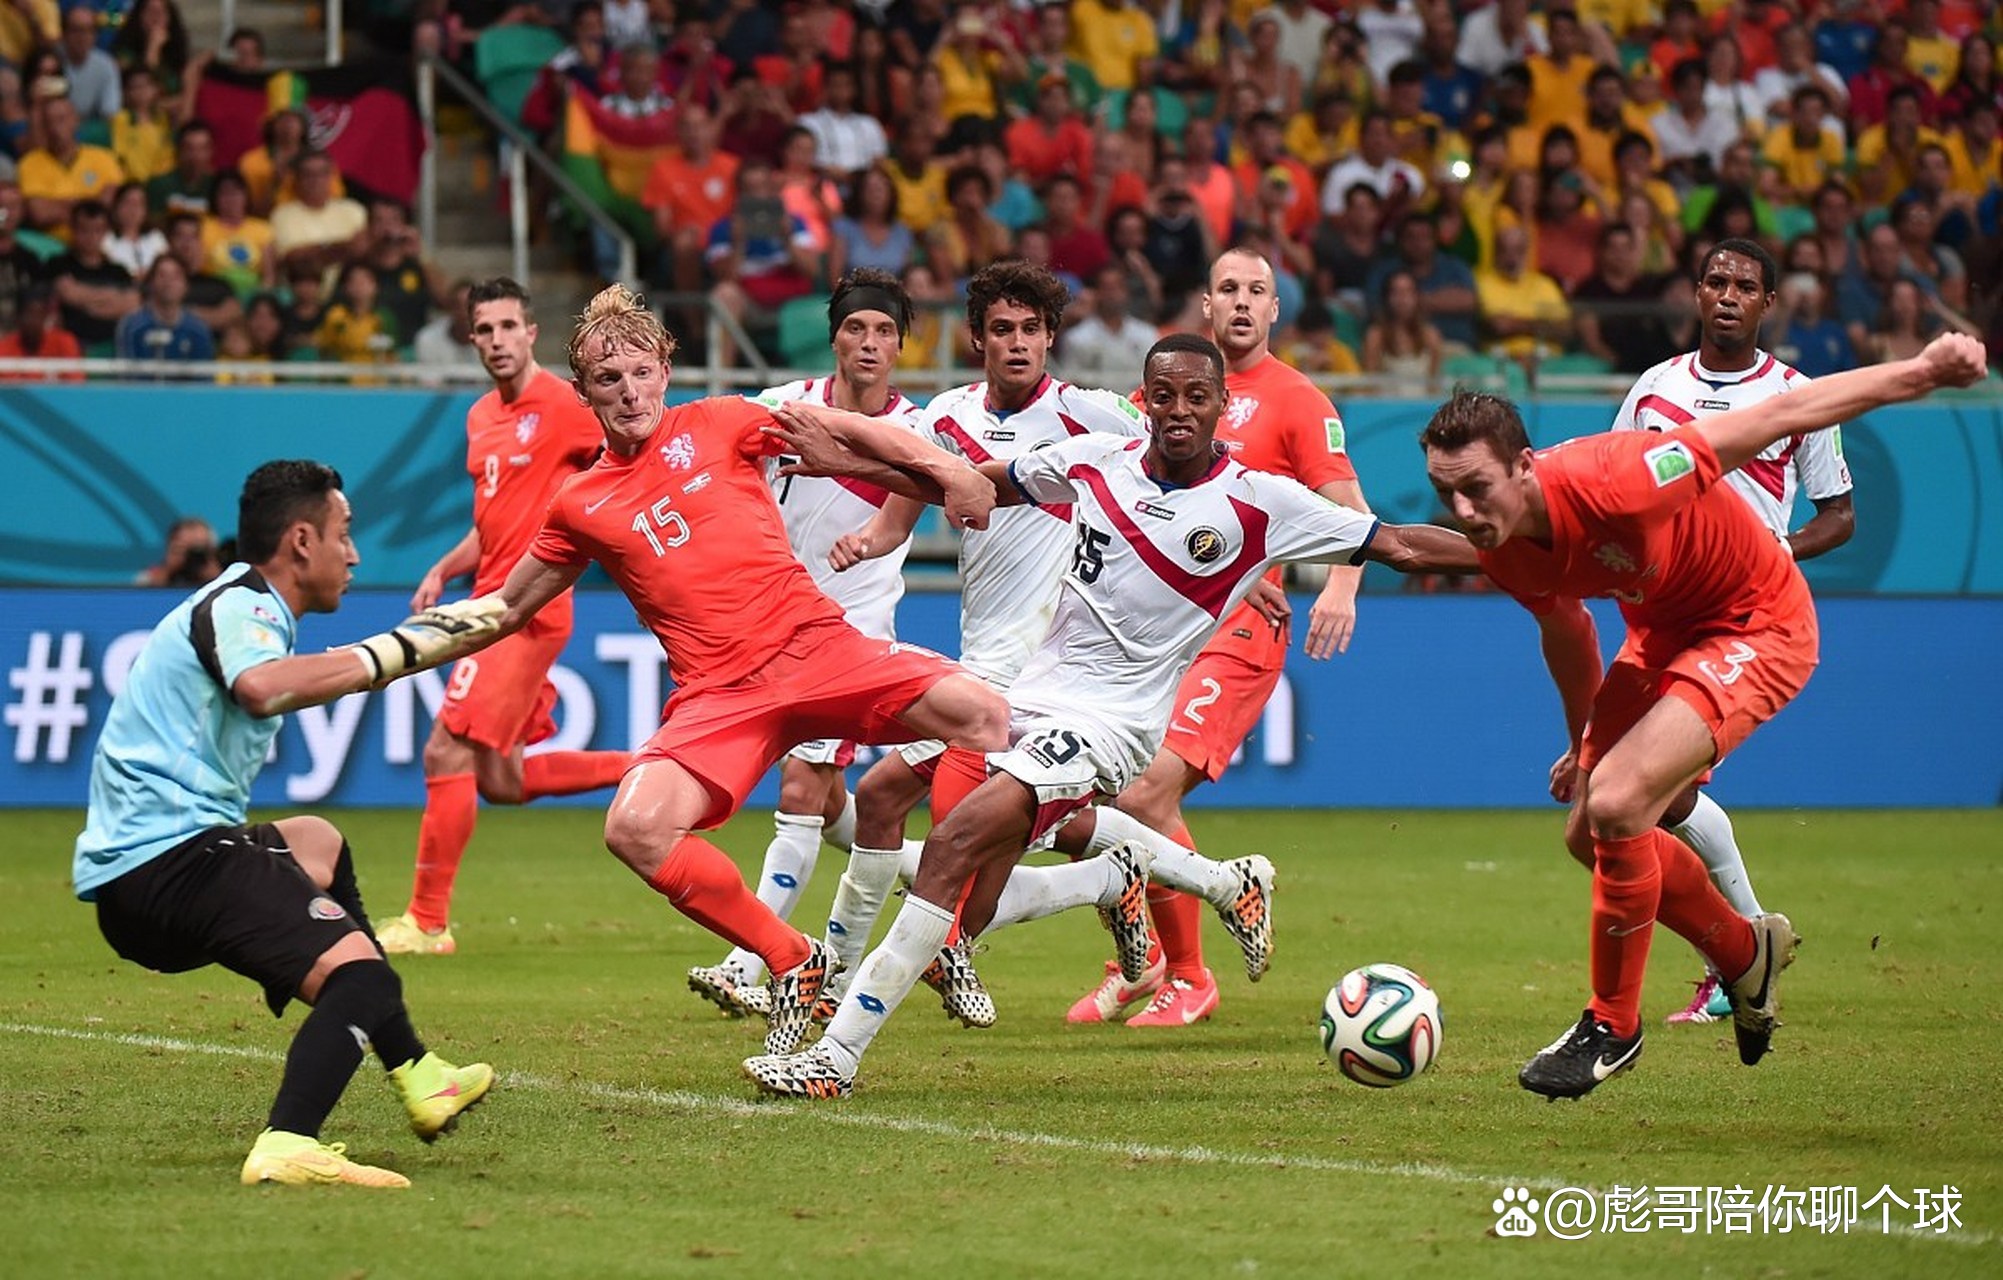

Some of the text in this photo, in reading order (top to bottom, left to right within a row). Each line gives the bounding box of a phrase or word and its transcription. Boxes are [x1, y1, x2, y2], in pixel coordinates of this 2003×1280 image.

[483, 454, 499, 498] 9
[632, 495, 691, 557] 15
[447, 657, 478, 699] 9
[1711, 641, 1757, 685] 3
[1184, 677, 1221, 725] 2
